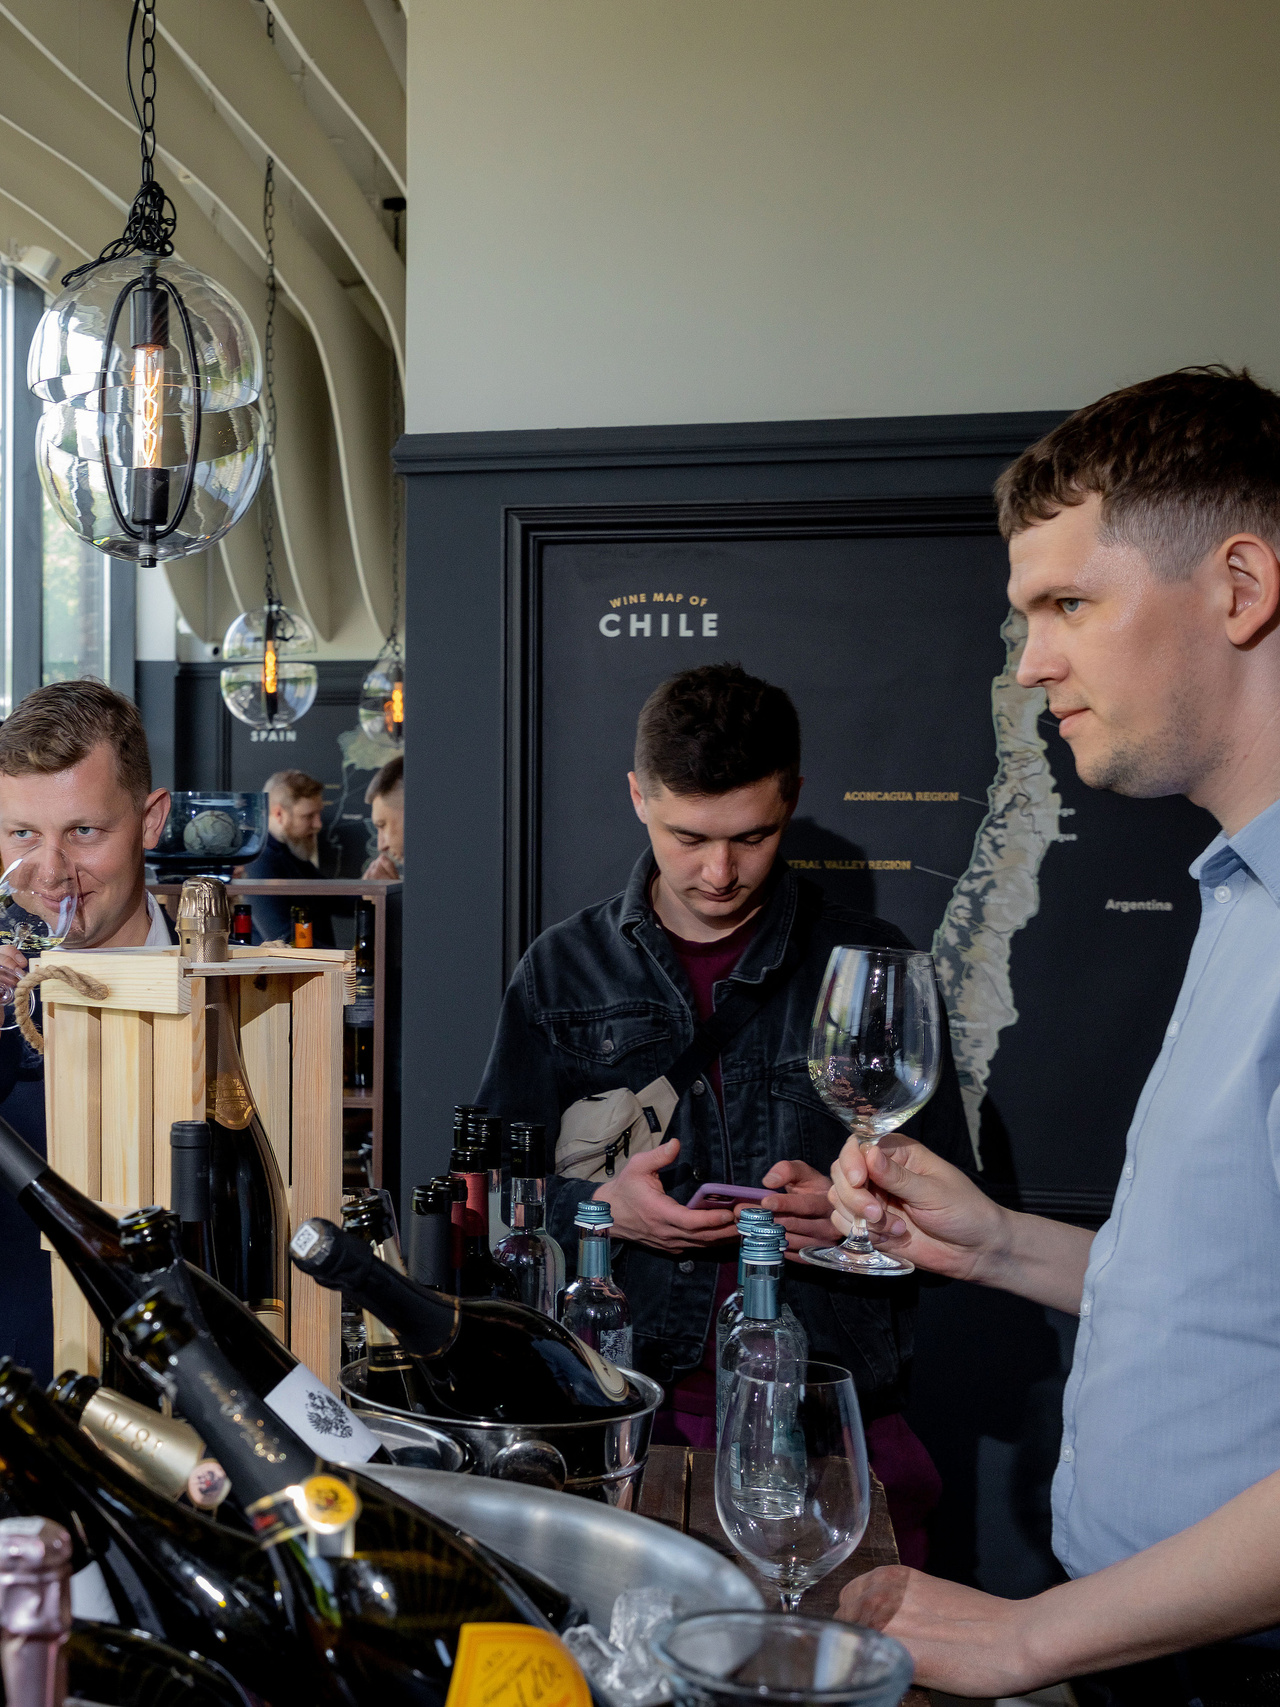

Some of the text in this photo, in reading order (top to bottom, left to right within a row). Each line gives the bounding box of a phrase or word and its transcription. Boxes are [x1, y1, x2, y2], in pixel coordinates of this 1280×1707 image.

[609, 592, 708, 608] WINE MAP OF
[598, 612, 719, 638] CHILE
[250, 729, 297, 743] SPAIN
[844, 791, 960, 802] ACONCAGUA REGION
[823, 859, 866, 870] VALLEY
[867, 859, 912, 870] REGION
[1104, 898, 1173, 913] Argentina
